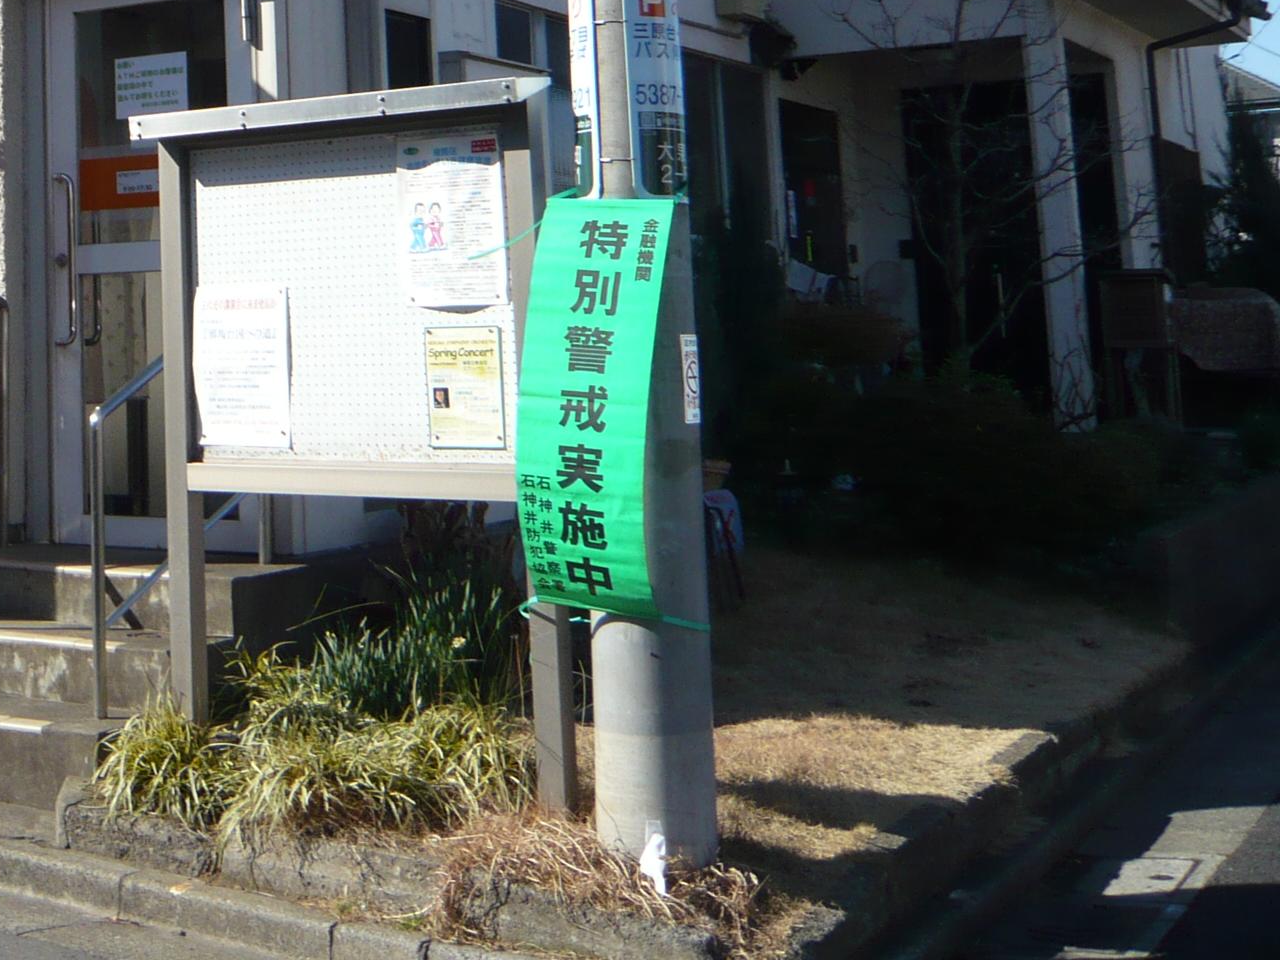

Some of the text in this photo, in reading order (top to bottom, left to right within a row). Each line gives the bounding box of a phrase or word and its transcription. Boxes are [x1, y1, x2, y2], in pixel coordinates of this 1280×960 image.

[634, 219, 660, 282] 金融機関
[428, 346, 494, 360] Spring Concert
[556, 220, 629, 597] 特別警戒実施中
[520, 474, 552, 590] 石神井防犯協会
[536, 476, 566, 592] 石神井警察署
